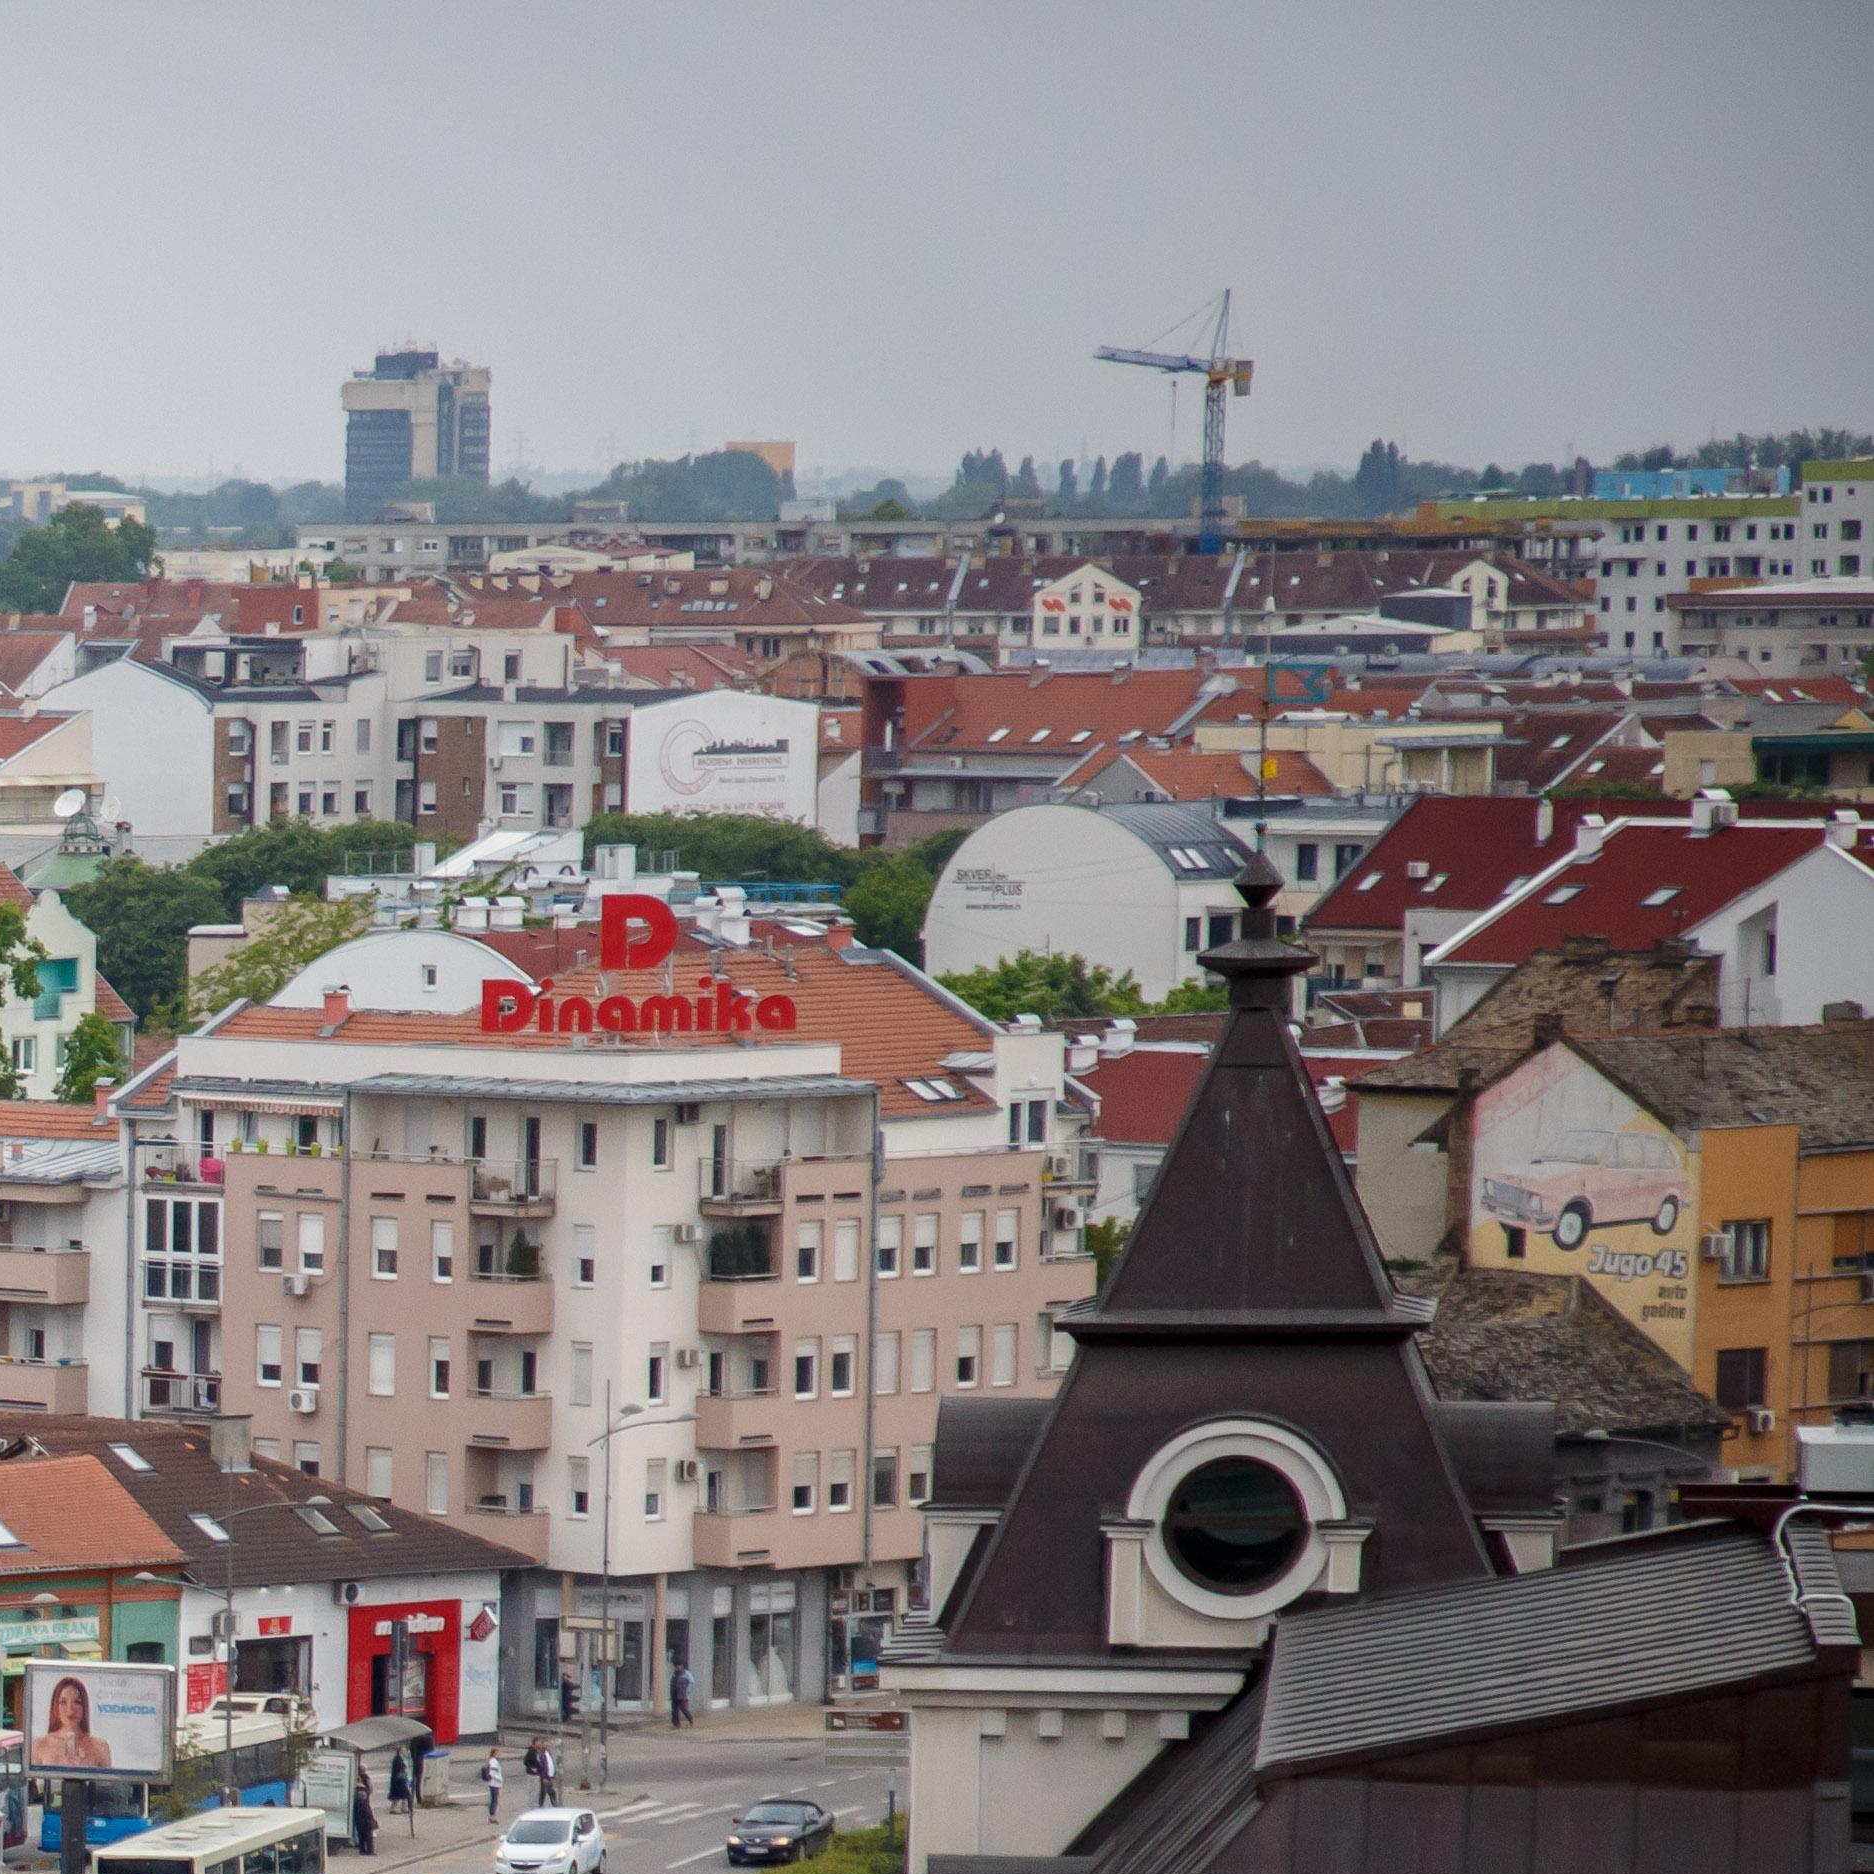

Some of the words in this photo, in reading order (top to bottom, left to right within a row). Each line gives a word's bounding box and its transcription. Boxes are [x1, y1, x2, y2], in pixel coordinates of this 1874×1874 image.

[956, 869, 992, 880] SKVER
[995, 884, 1022, 896] PLUS
[600, 893, 678, 971] D
[481, 976, 797, 1033] Dinamika
[1588, 1243, 1654, 1282] Jugo
[1654, 1247, 1689, 1280] 45
